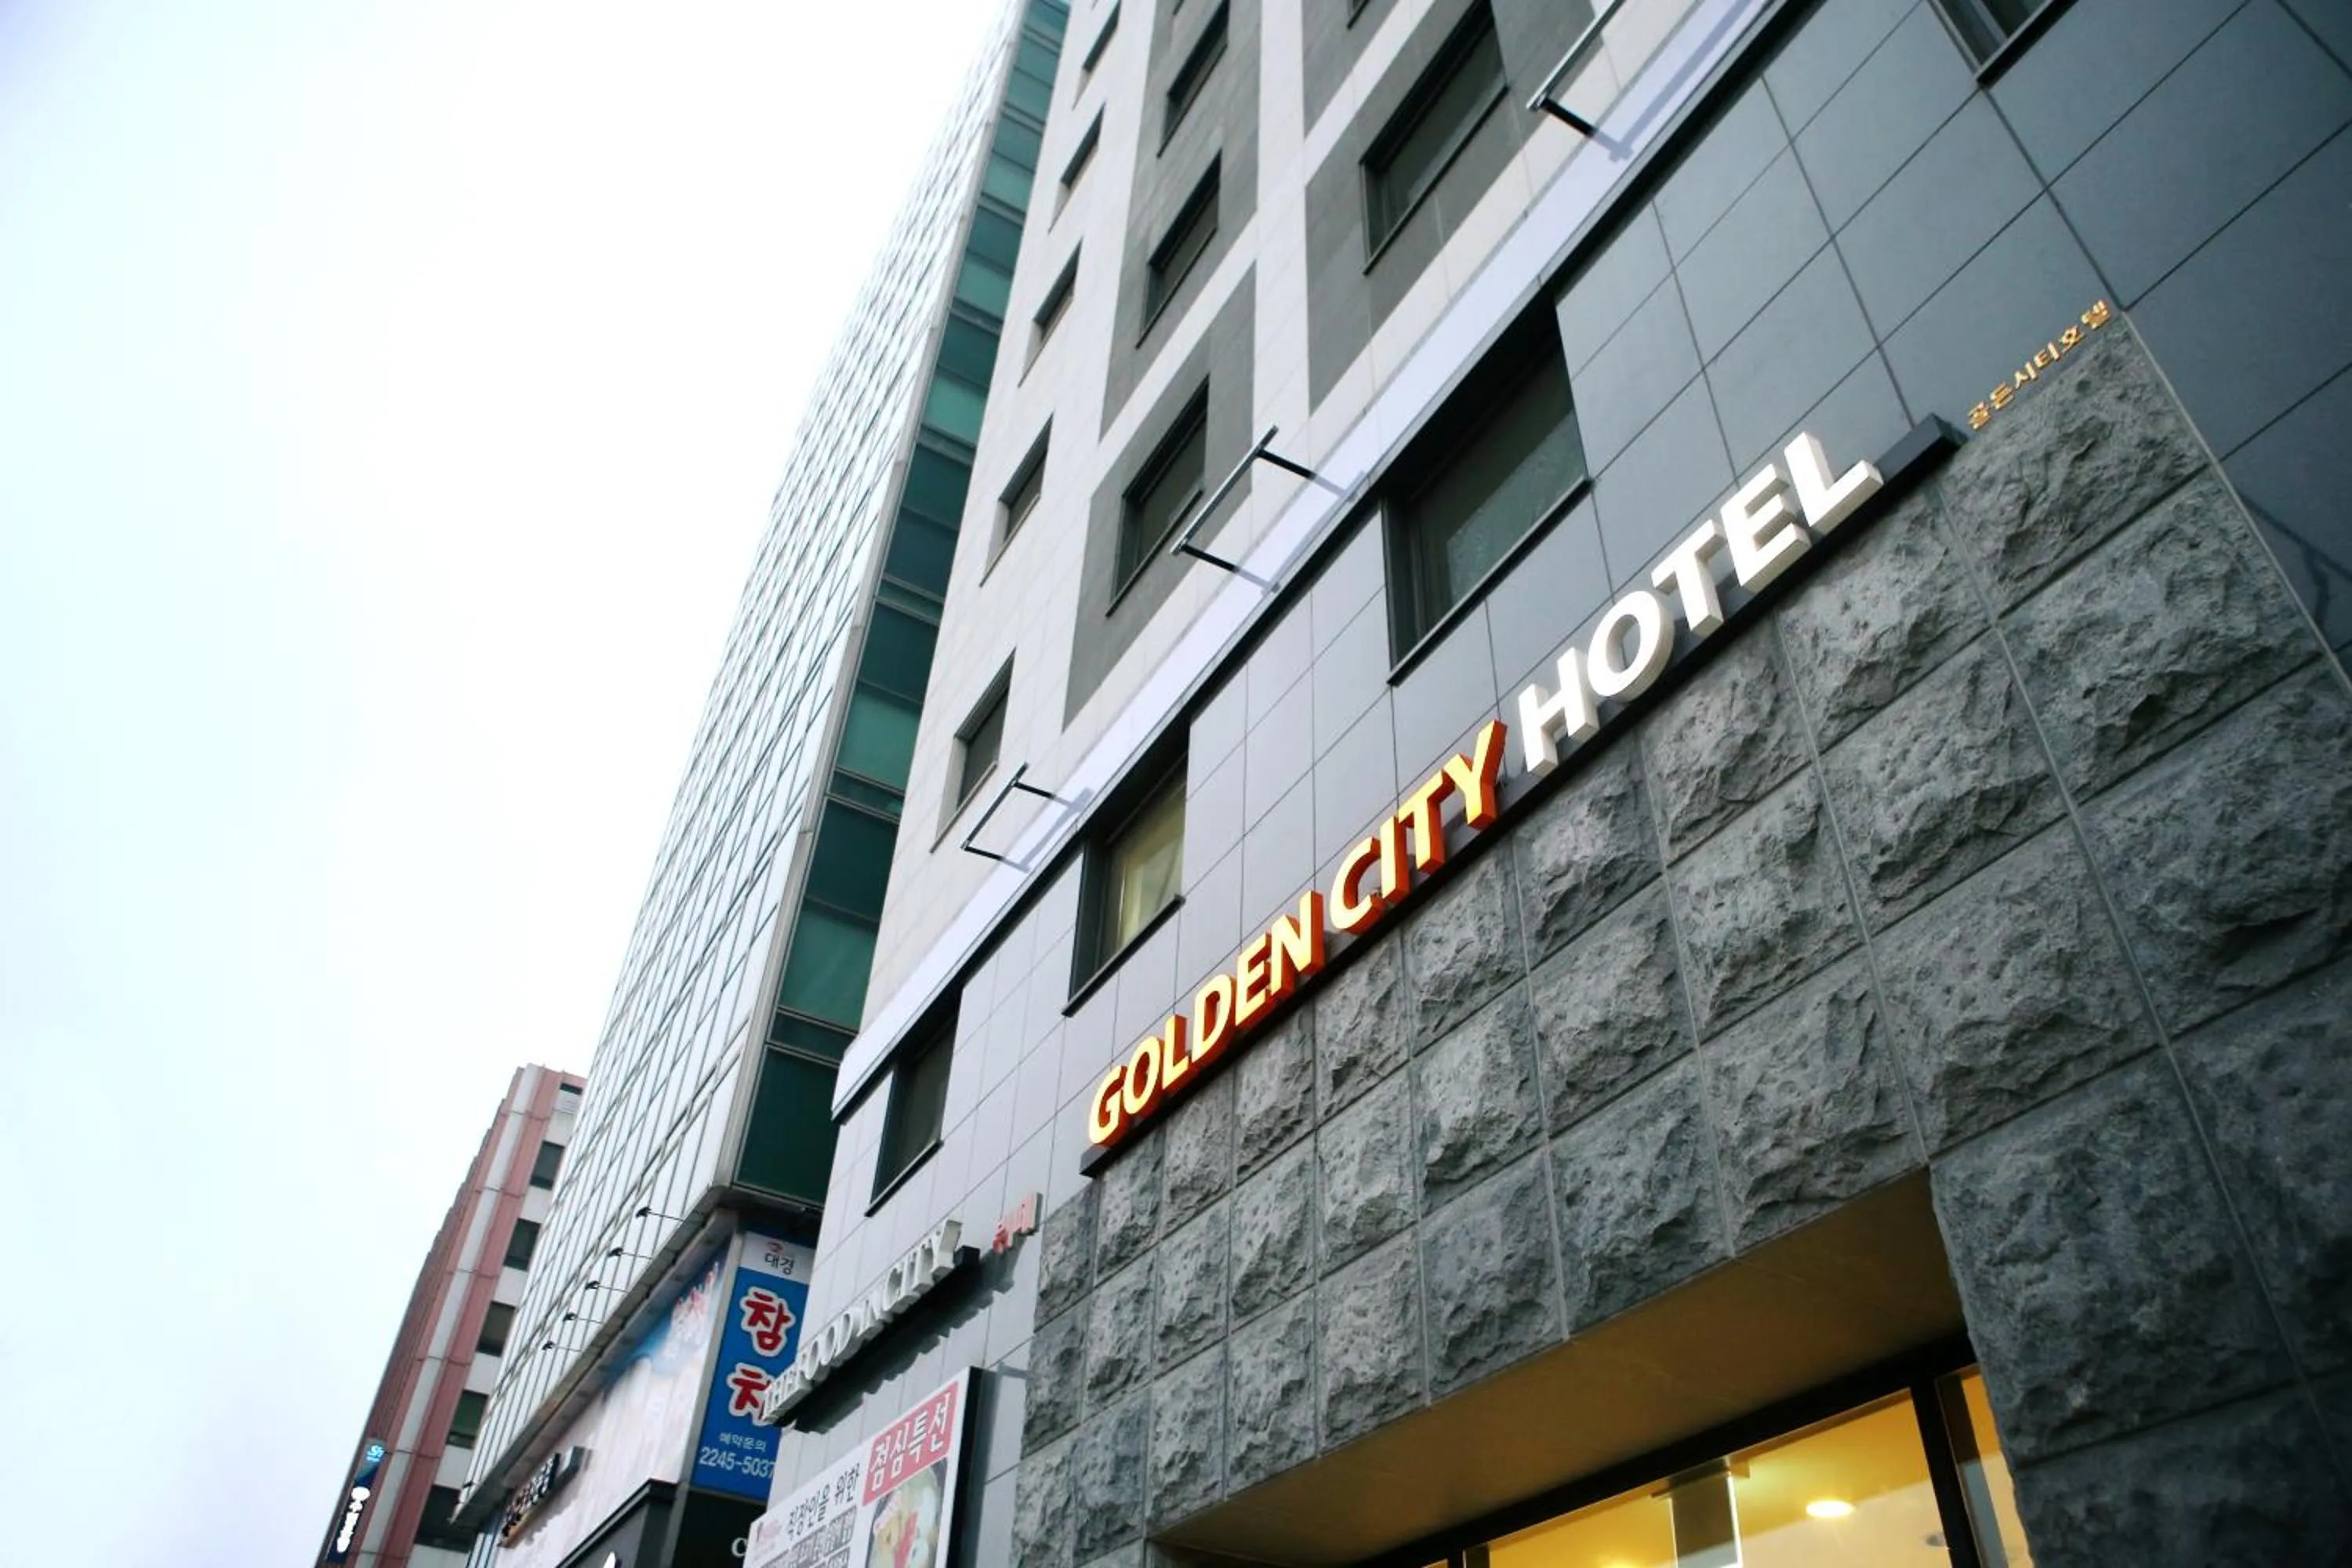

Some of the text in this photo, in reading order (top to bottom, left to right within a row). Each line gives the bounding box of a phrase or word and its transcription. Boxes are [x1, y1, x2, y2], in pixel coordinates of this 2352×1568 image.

[1088, 432, 1884, 1149] GOLDEN CITY HOTEL
[764, 1252, 793, 1276] 대경
[796, 1307, 858, 1386] FOOD
[884, 1220, 963, 1314] CITY
[719, 1432, 767, 1453] 예약문의
[870, 1392, 951, 1492] 점심특선
